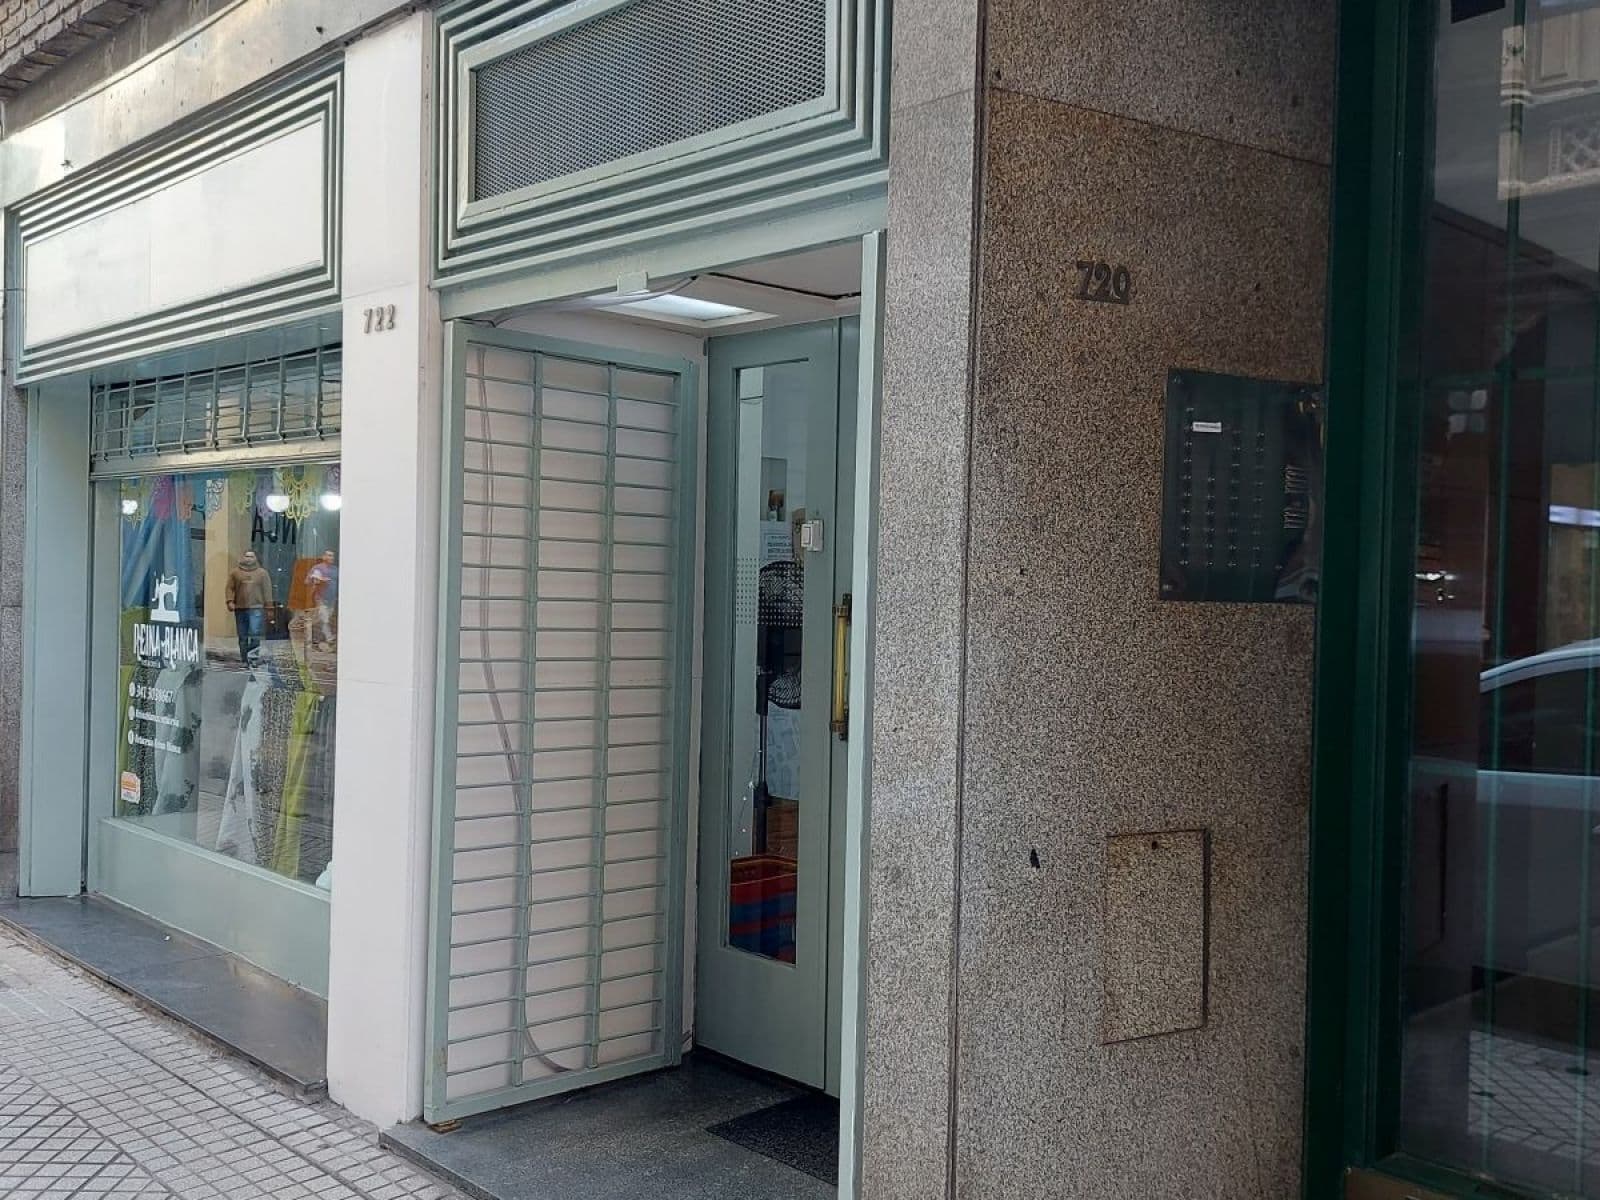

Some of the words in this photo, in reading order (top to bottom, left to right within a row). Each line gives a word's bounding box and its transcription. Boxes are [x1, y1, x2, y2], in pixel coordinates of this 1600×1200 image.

[1077, 261, 1130, 304] 720
[363, 304, 396, 334] 722
[133, 623, 161, 661] REINA
[162, 626, 199, 670] BLANCA
